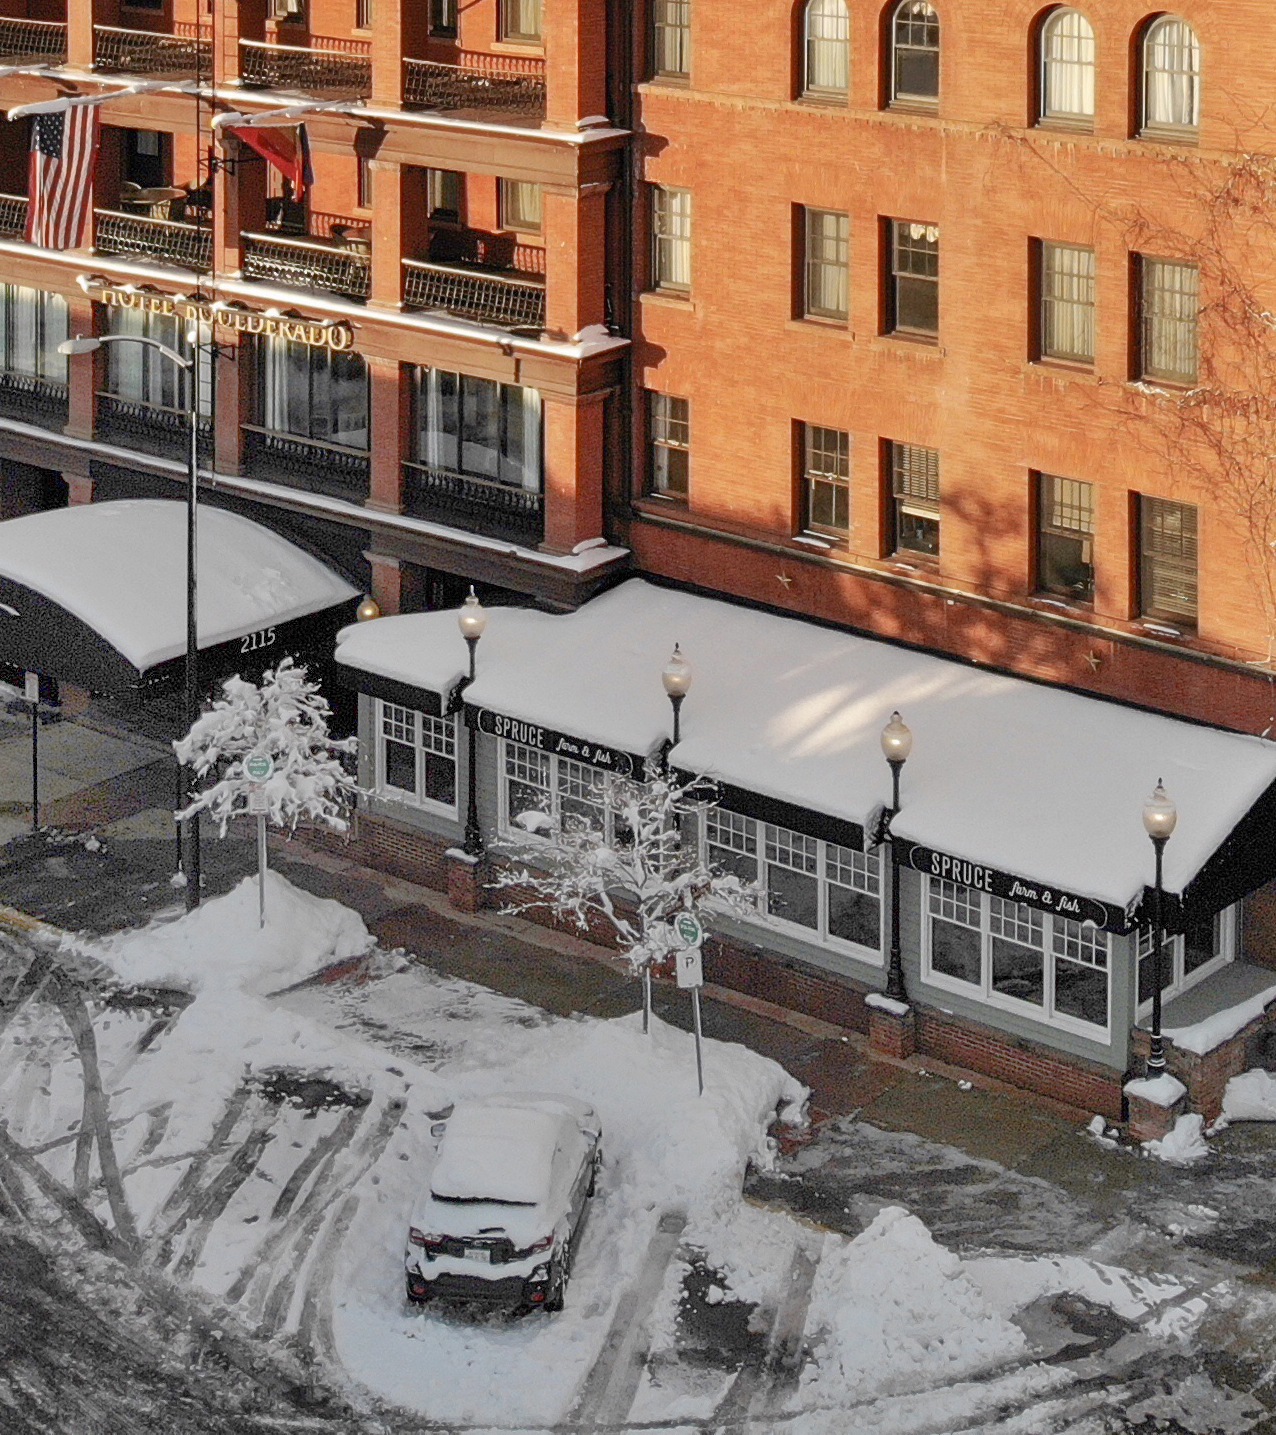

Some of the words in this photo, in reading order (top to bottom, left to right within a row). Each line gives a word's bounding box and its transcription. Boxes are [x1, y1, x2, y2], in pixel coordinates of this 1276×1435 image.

[101, 289, 174, 317] HOTEL
[240, 627, 276, 654] 2115
[494, 715, 544, 749] SPRUCE
[931, 852, 993, 892] SPRUCE
[1008, 881, 1039, 901] farm
[1041, 890, 1053, 904] &
[1055, 895, 1081, 913] fish
[685, 956, 695, 970] P
